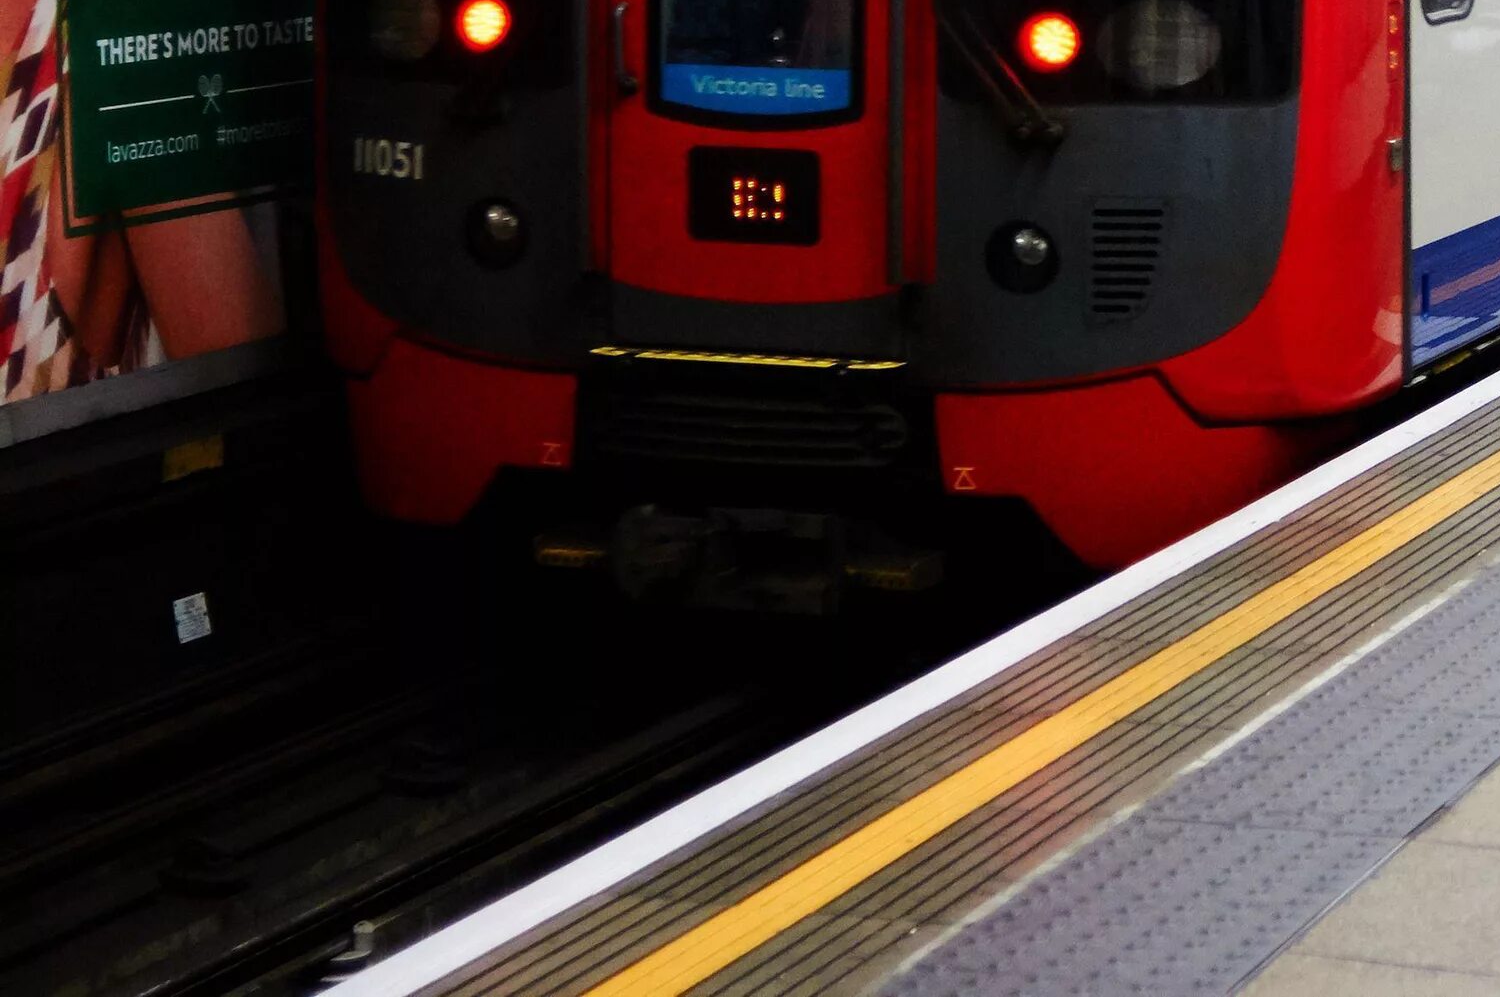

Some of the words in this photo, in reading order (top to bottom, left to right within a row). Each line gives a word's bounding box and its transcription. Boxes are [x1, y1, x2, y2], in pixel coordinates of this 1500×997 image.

[97, 31, 173, 66] THERE'S
[177, 26, 232, 56] MORE
[233, 22, 260, 49] TO
[264, 15, 314, 46] TASTE
[691, 73, 778, 98] Victoria
[783, 77, 826, 100] line
[107, 132, 199, 164] lavazza.com
[353, 136, 425, 181] 11051
